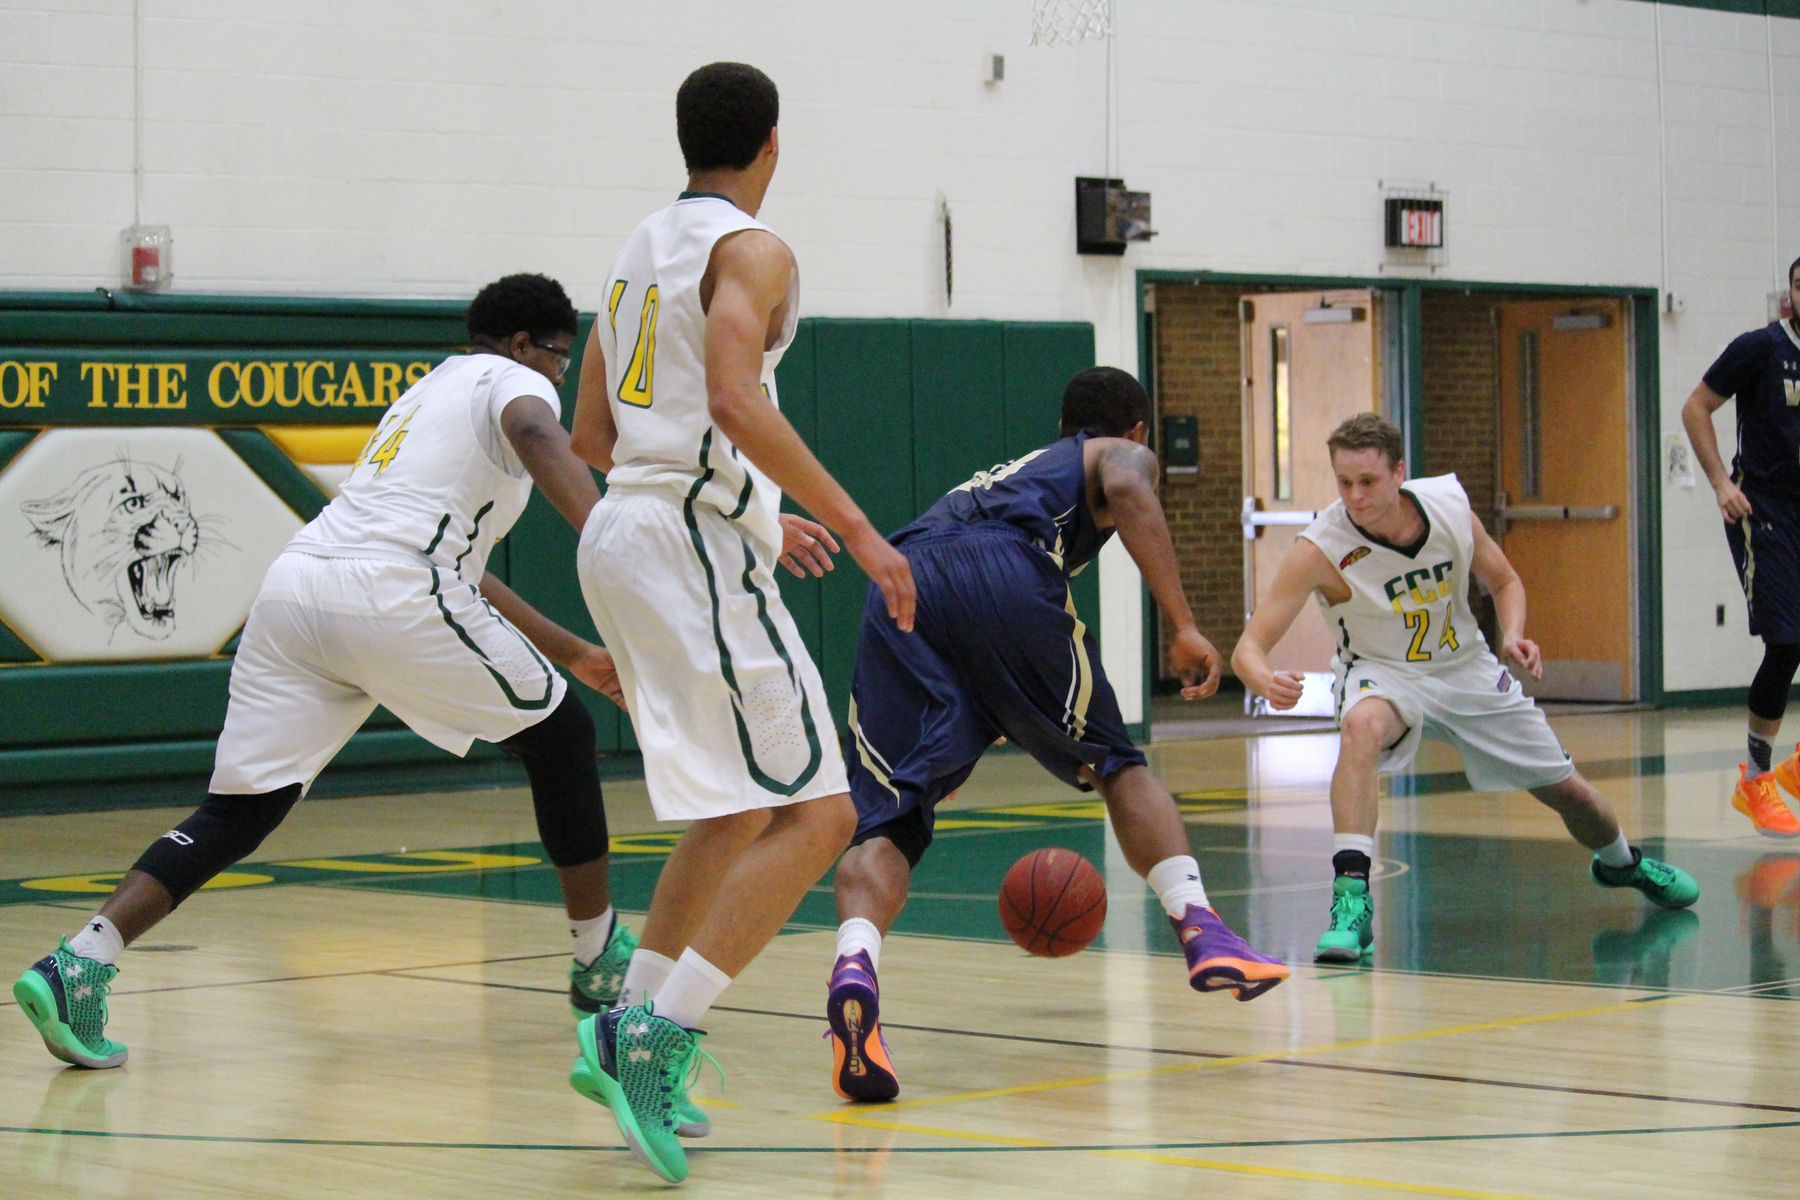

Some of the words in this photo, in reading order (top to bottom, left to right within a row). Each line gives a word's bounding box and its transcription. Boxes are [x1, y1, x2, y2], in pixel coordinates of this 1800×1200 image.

[1407, 210, 1437, 245] EXIT
[0, 361, 58, 408] OF
[80, 362, 187, 409] THE
[1384, 560, 1453, 614] FCC
[1403, 601, 1460, 662] 24
